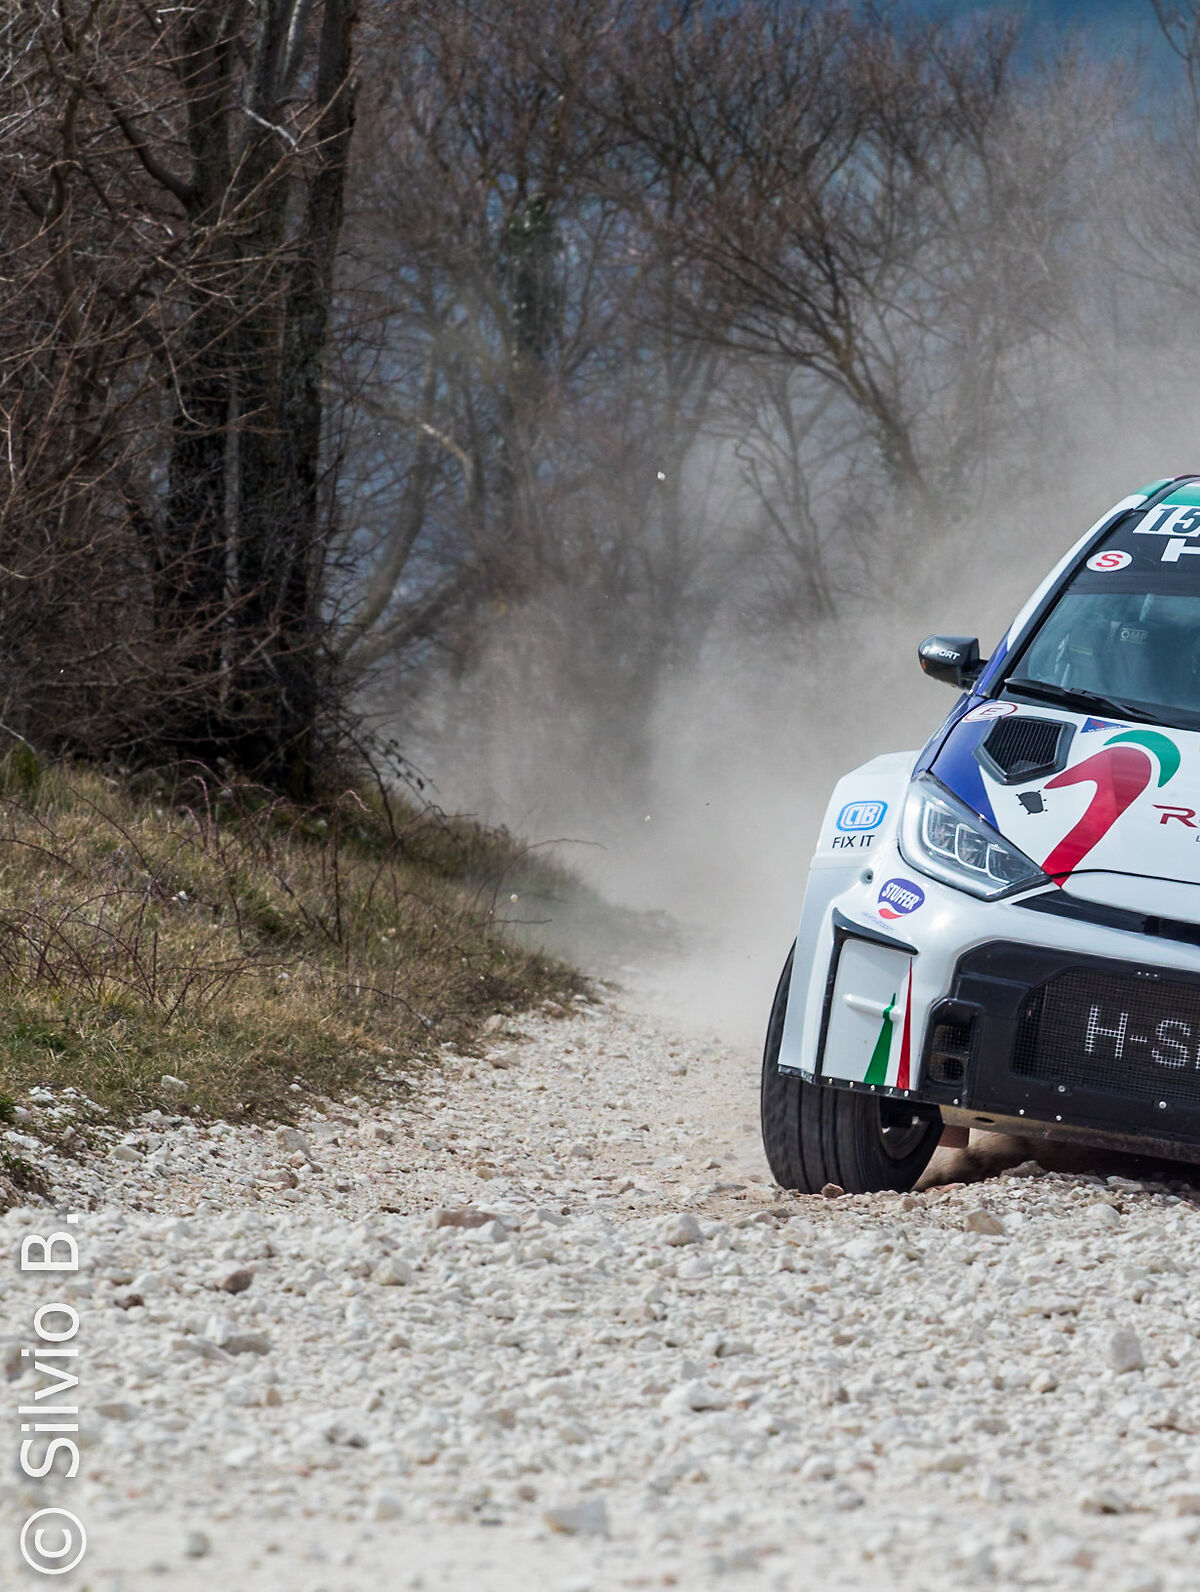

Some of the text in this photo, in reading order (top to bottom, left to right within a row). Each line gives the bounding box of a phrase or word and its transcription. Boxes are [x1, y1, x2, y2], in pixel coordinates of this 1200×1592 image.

[1096, 553, 1124, 568] S
[832, 834, 875, 849] FIX IT
[882, 882, 920, 910] STUFFER
